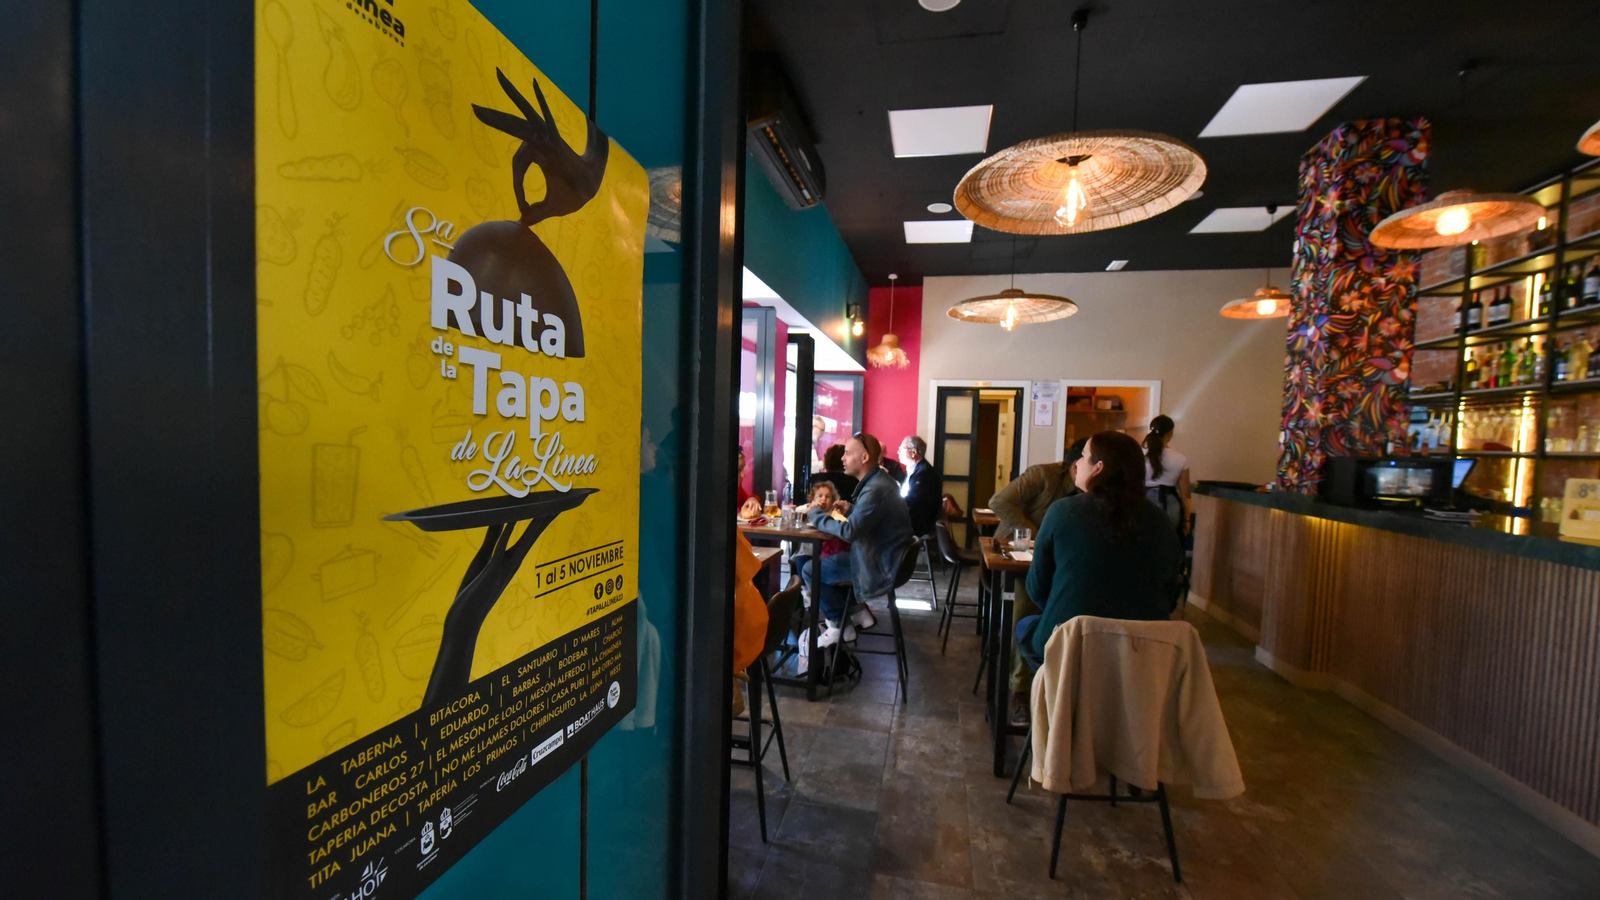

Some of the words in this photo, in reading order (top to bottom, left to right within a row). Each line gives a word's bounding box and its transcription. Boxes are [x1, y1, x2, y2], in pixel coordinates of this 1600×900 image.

[431, 254, 565, 359] Ruta
[431, 336, 454, 355] de
[441, 359, 456, 379] la
[458, 344, 585, 439] Tapa
[451, 429, 479, 461] de
[467, 429, 530, 498] La
[521, 431, 599, 492] Línea
[535, 572, 541, 589] 1
[545, 566, 557, 585] al
[559, 564, 566, 580] 5
[569, 545, 624, 577] NOVIEMBRE
[306, 775, 326, 795] LA
[340, 734, 403, 775] TABERNA
[429, 691, 481, 726] BITÁCORA
[501, 675, 511, 688] EL
[517, 648, 558, 678] SANTUARIO
[307, 791, 337, 820] BAR
[355, 751, 408, 790] CARLOS
[421, 738, 428, 751] Y
[440, 703, 490, 740] EDUARDO
[512, 673, 541, 697] BARBAS
[558, 647, 589, 670] BODEBAR
[308, 772, 407, 842] CARBONEROS
[410, 761, 425, 779] 27
[436, 748, 448, 763] EL
[449, 721, 486, 753] MESÓN
[488, 714, 500, 728] DE
[501, 699, 523, 721] LOLO
[529, 682, 556, 702] MESÓN
[557, 663, 586, 686] ALFREDO
[591, 656, 599, 666] LA
[308, 820, 367, 866] TAPERIA
[371, 780, 429, 826] DECOSTA
[441, 756, 459, 778] NO
[461, 744, 476, 765] ME
[477, 727, 509, 754] LLAMES
[510, 703, 545, 731] DOLORES
[551, 687, 569, 703] CASA
[570, 677, 585, 692] PURI
[308, 861, 341, 889] TITA
[350, 823, 397, 863] JUANA
[417, 778, 457, 814] TAPERÍA
[463, 760, 481, 782] LOS
[486, 735, 517, 765] PRIMOS
[530, 697, 576, 734] CHIRINGUITO
[580, 691, 587, 701] LA
